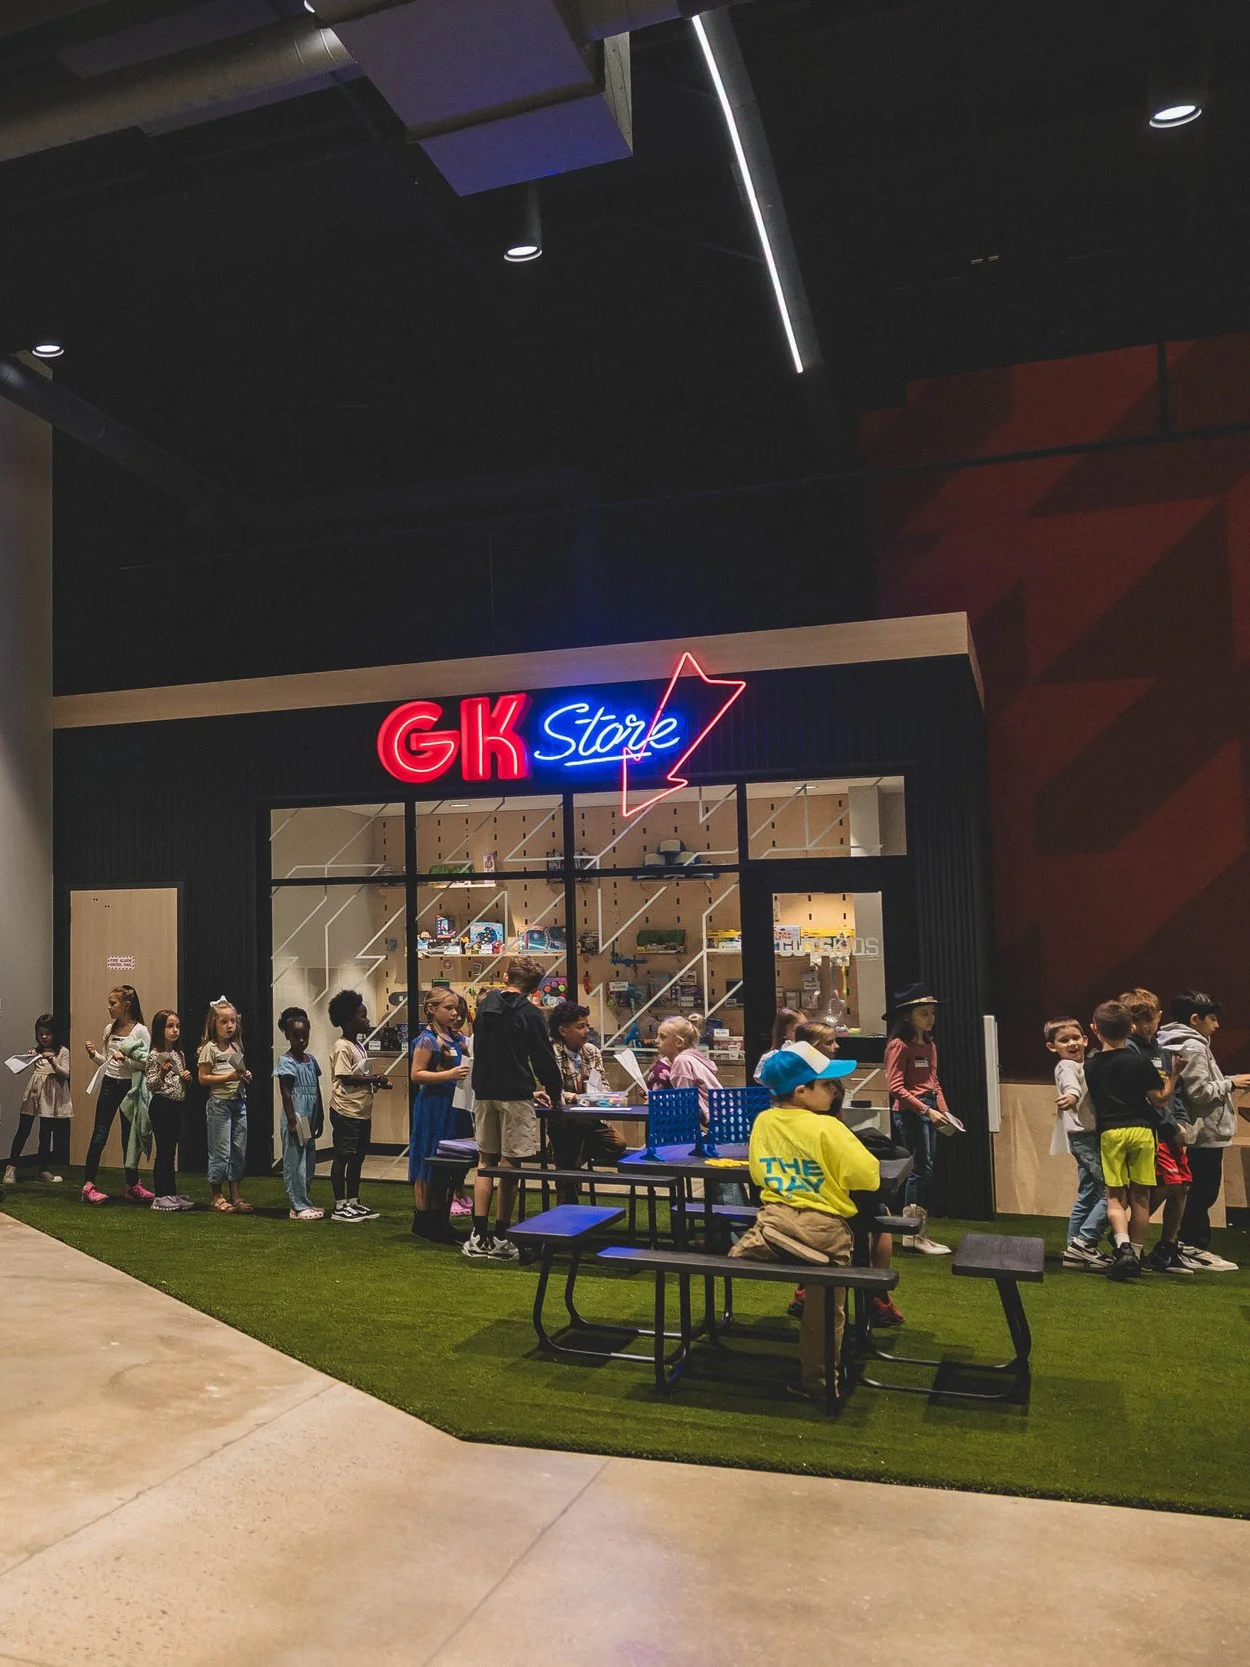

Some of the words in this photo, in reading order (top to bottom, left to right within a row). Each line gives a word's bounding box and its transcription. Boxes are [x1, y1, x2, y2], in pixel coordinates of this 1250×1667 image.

[377, 692, 528, 784] GK
[534, 702, 680, 761] Store
[758, 1156, 825, 1176] THE
[763, 1175, 826, 1197] DAY
